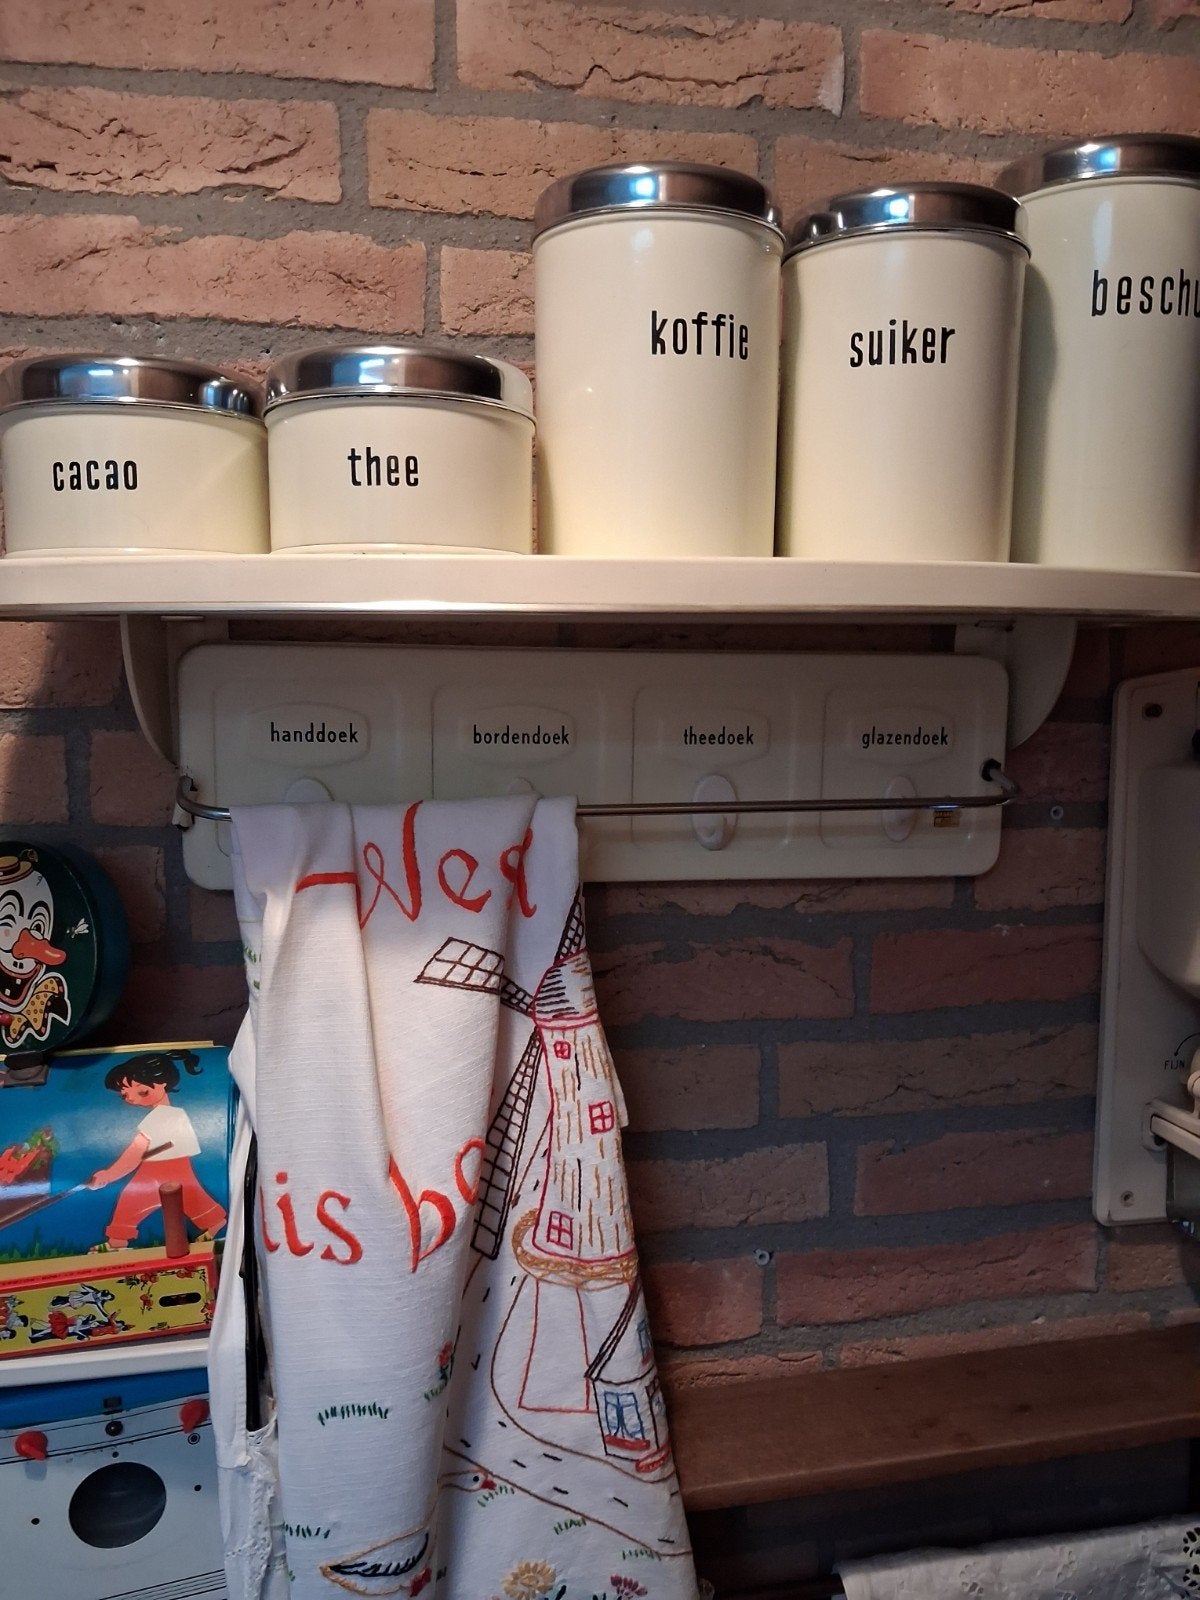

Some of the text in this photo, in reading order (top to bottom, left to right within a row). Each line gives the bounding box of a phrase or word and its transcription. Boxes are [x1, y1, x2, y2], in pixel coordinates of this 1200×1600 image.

[651, 310, 749, 361] koffie
[849, 318, 956, 368] suiker
[52, 459, 138, 492] cacao
[347, 446, 419, 487] thee
[270, 721, 359, 743] handdoek
[473, 724, 570, 745] bordendoek
[683, 725, 754, 745] theedoek
[861, 725, 949, 750] glazendoek
